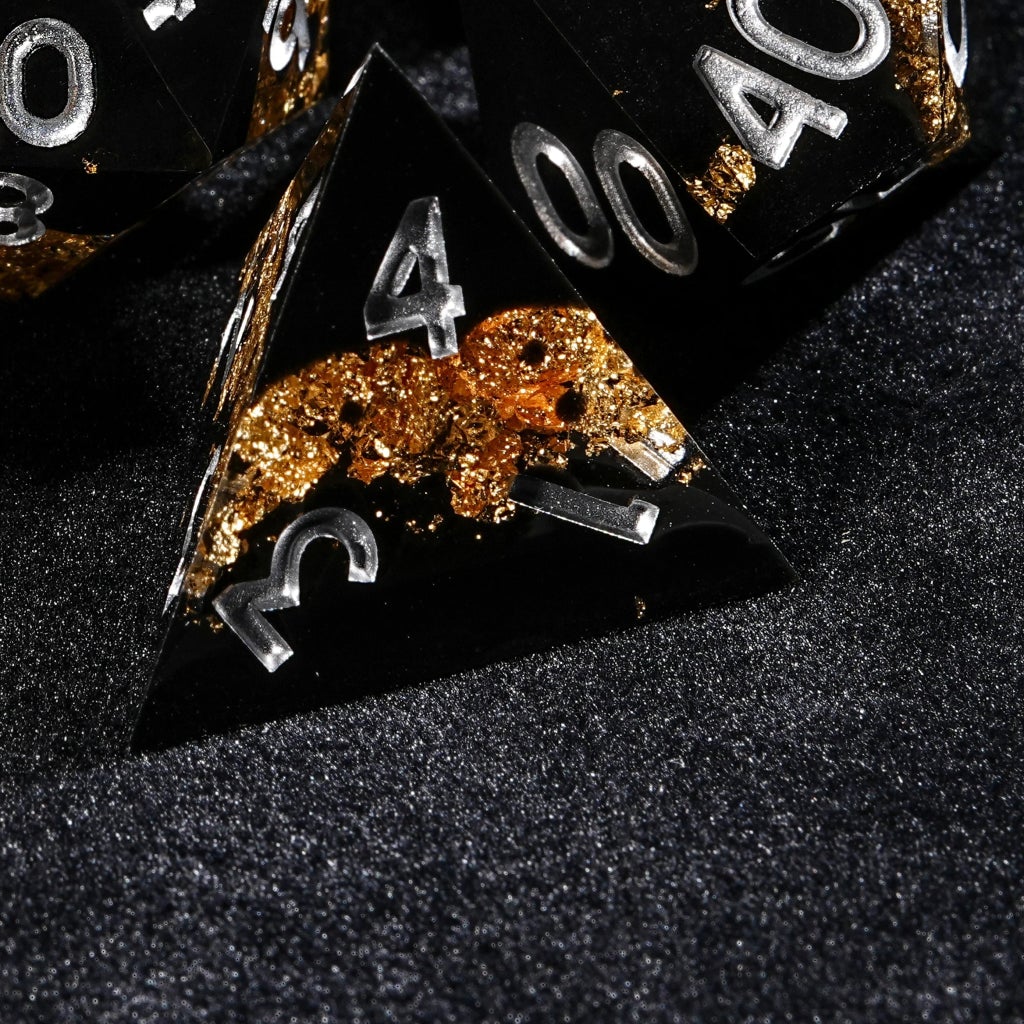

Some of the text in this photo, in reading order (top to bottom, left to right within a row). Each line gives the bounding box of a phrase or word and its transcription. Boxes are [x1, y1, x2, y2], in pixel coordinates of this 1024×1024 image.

[511, 122, 698, 276] 00
[363, 195, 467, 360] 4
[508, 476, 661, 545] 1
